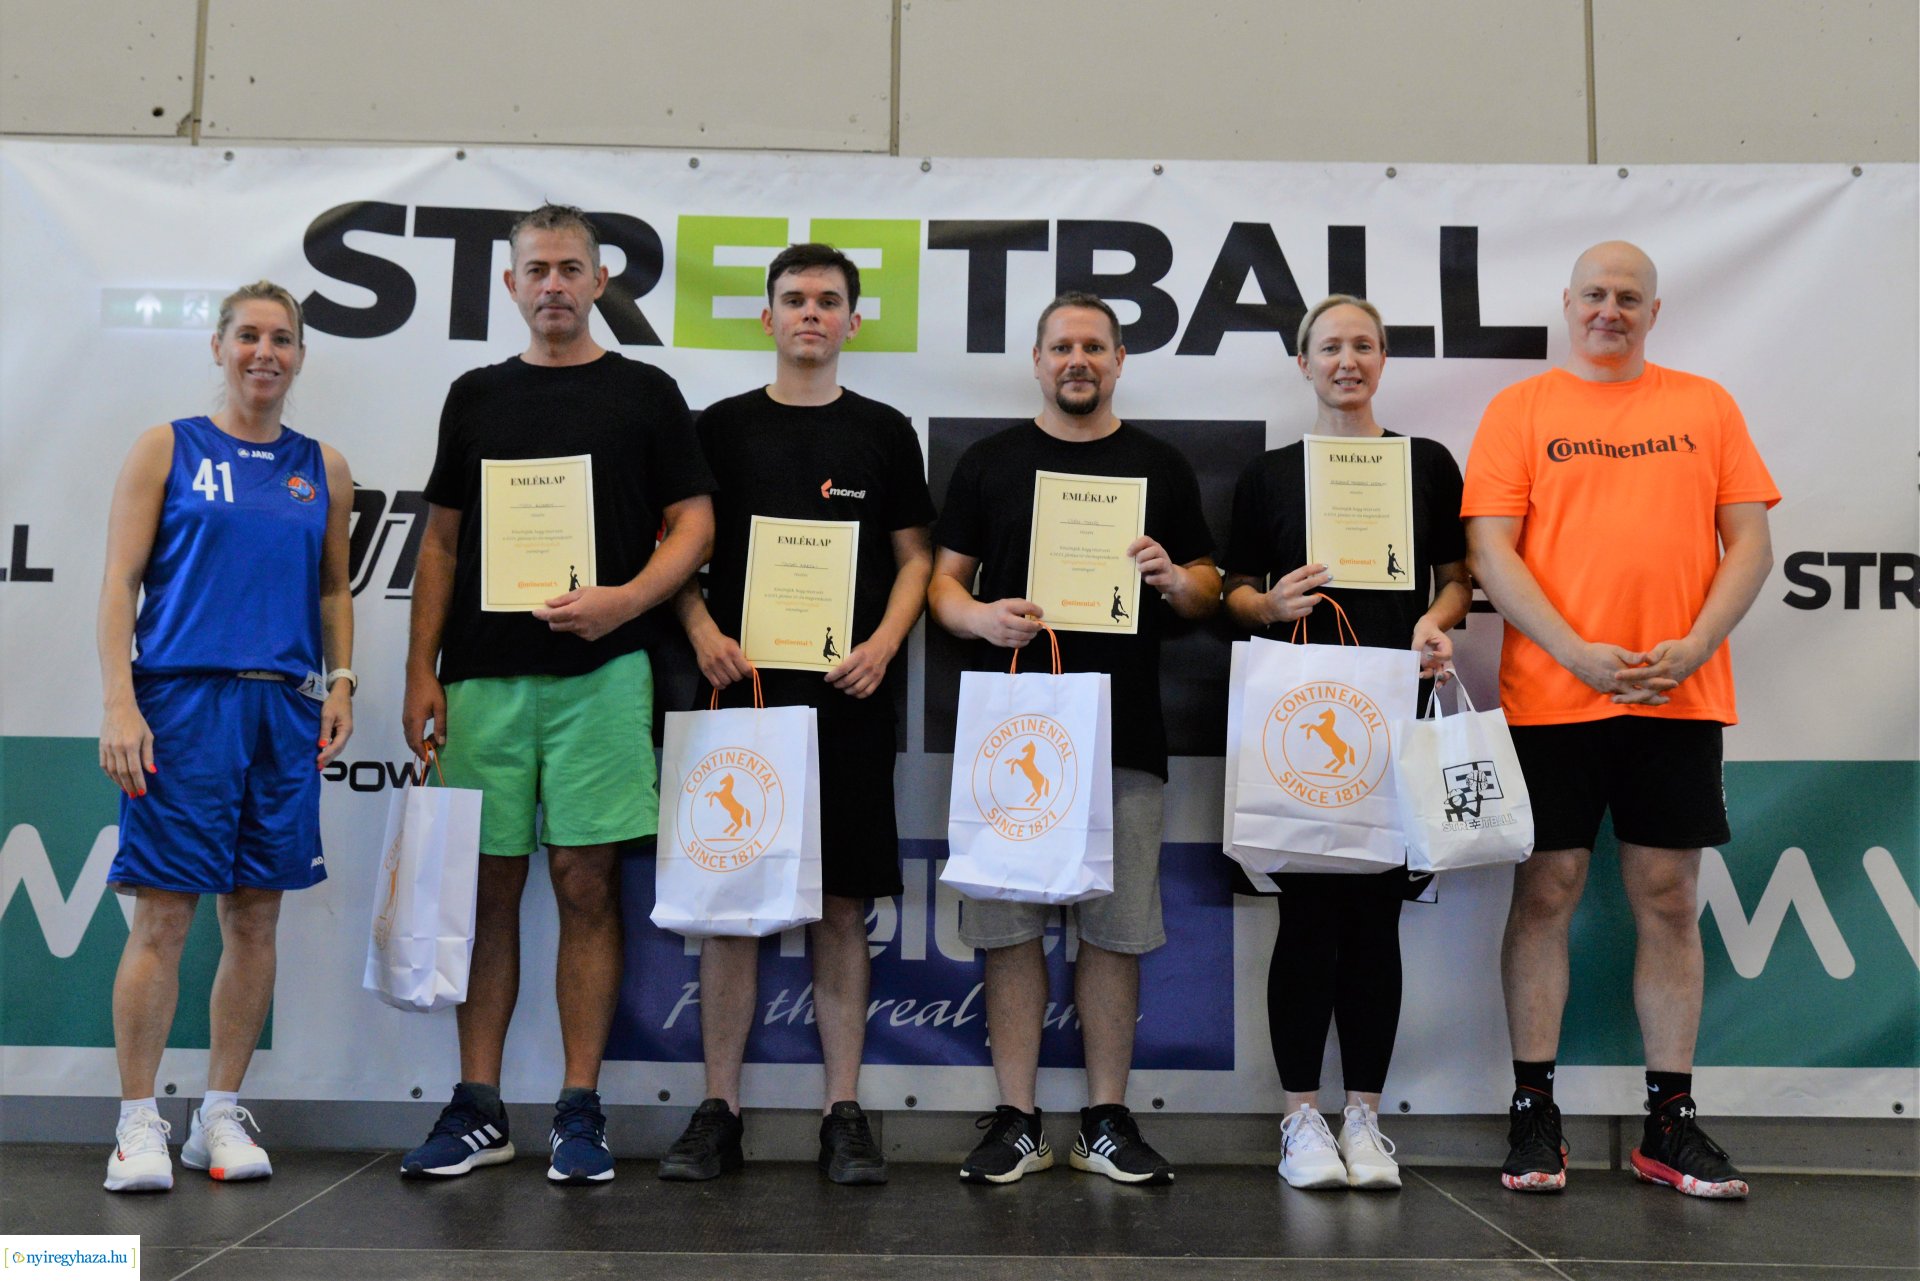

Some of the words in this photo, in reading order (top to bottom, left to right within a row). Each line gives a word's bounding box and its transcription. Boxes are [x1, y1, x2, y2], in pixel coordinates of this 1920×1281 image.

[303, 201, 1548, 359] STREETBALL
[251, 450, 275, 461] JAKO
[1329, 453, 1383, 464] EMLÉKLAP
[1547, 434, 1678, 462] Continental
[192, 458, 234, 503] 41
[510, 475, 566, 487] EMLÉKLAP
[829, 487, 866, 499] mondi
[1062, 491, 1118, 503] EMLÉKLAP
[777, 535, 832, 547] EMLÉKLAP
[1275, 686, 1381, 733] CONTINENTAL
[984, 719, 1072, 763] CONTINENTAL
[685, 752, 776, 794] CONTINENTAL
[1280, 771, 1329, 804] SINCE
[1335, 778, 1369, 803] 1871
[988, 807, 1023, 837] SINCE
[1029, 810, 1057, 835] 1871
[687, 840, 727, 868] SINCE
[732, 840, 763, 865] 1871
